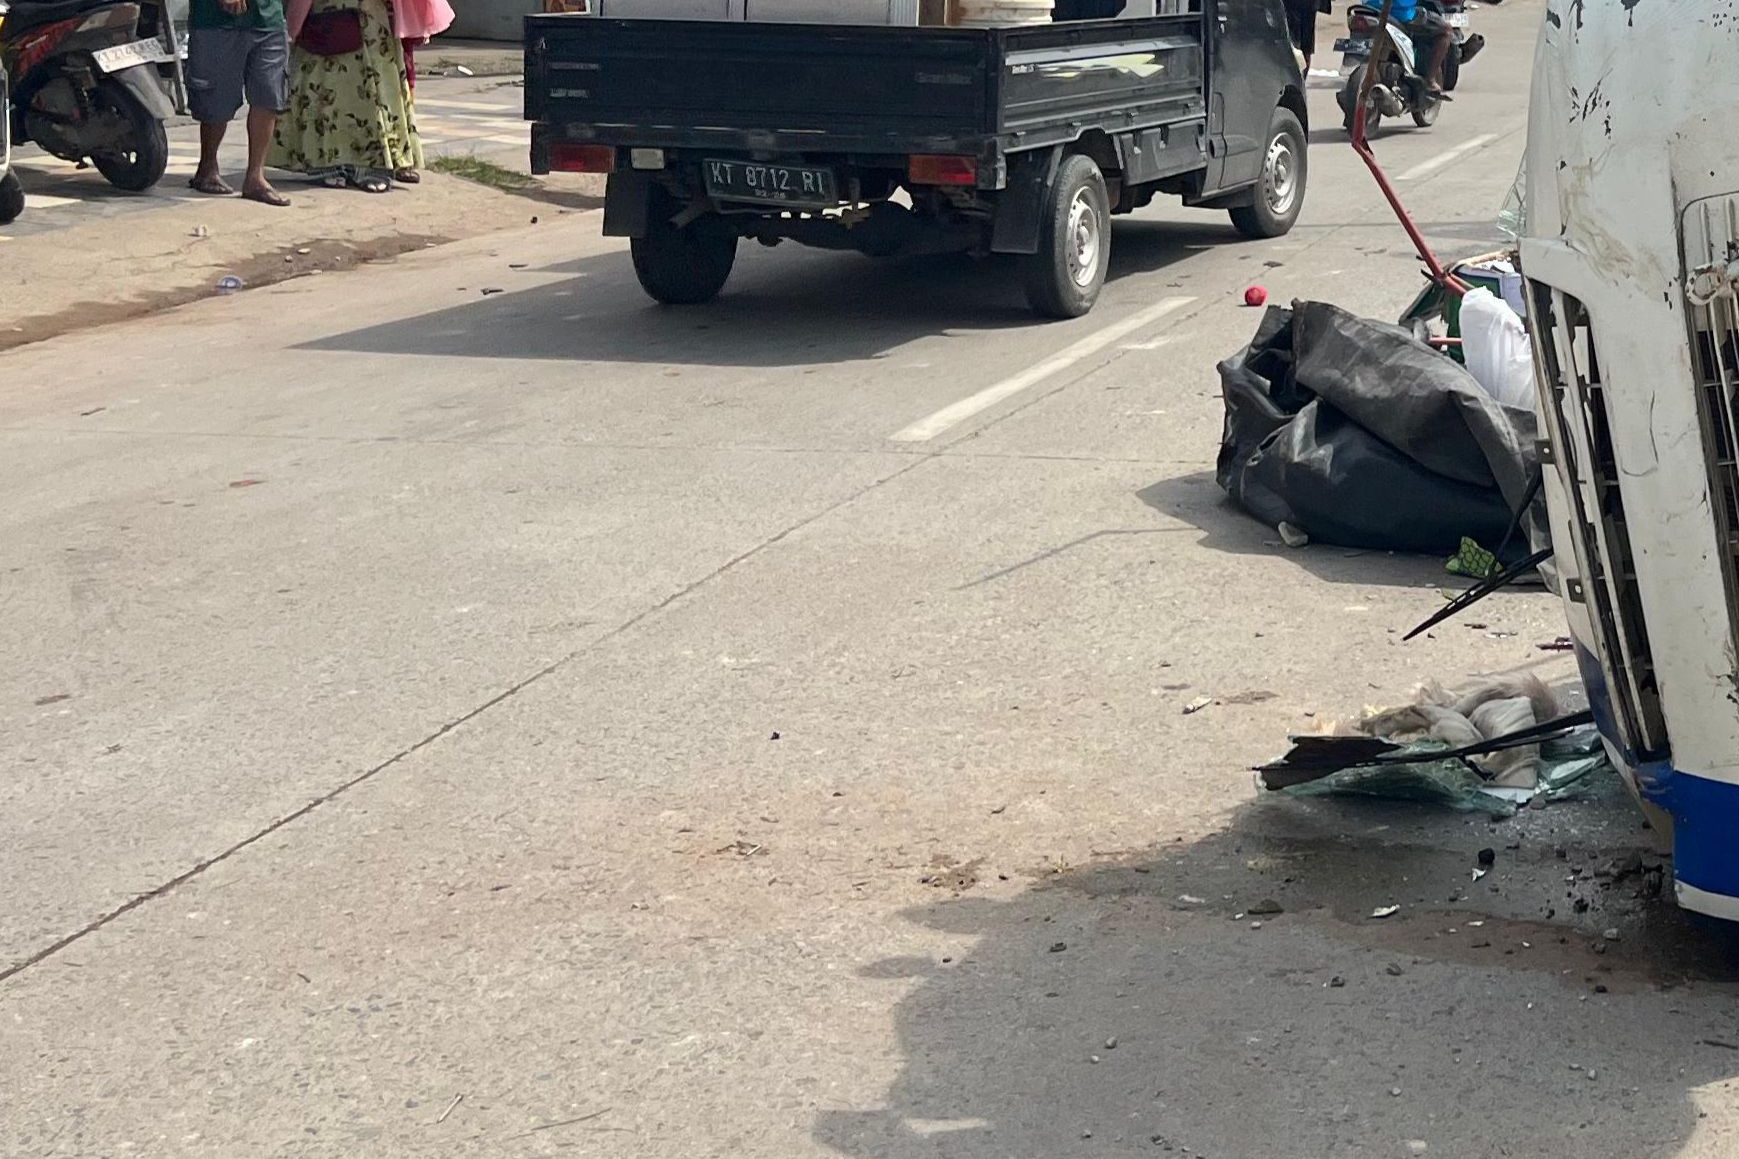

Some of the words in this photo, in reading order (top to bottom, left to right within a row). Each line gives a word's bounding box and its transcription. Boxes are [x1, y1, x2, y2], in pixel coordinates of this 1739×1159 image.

[710, 162, 736, 184] KT
[745, 166, 791, 190] 8712
[801, 171, 824, 193] RI
